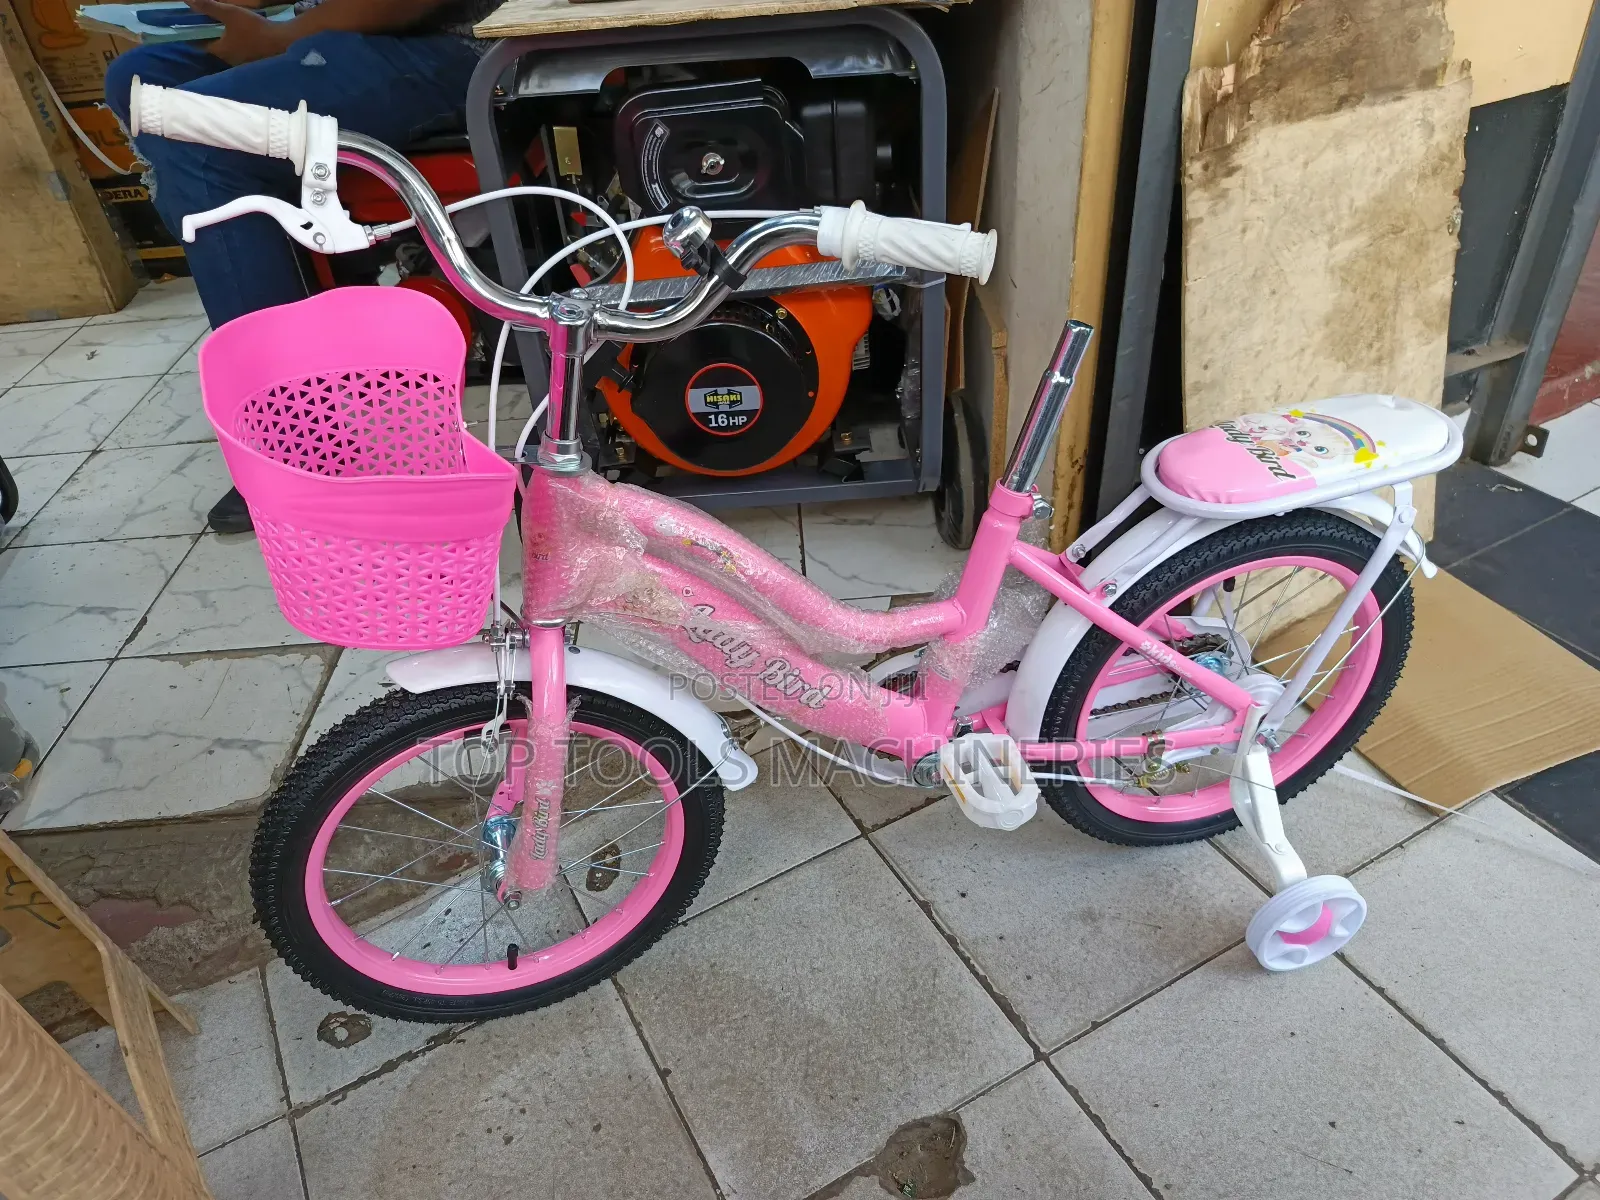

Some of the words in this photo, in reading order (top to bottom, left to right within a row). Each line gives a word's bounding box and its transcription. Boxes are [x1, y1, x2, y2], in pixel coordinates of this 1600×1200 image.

[24, 71, 56, 133] PUMP
[706, 394, 741, 402] HISAKI
[708, 413, 728, 428] 16
[729, 415, 748, 426] HP
[1245, 445, 1297, 481] Bird
[681, 603, 761, 668] Lady
[758, 656, 834, 709] Bird
